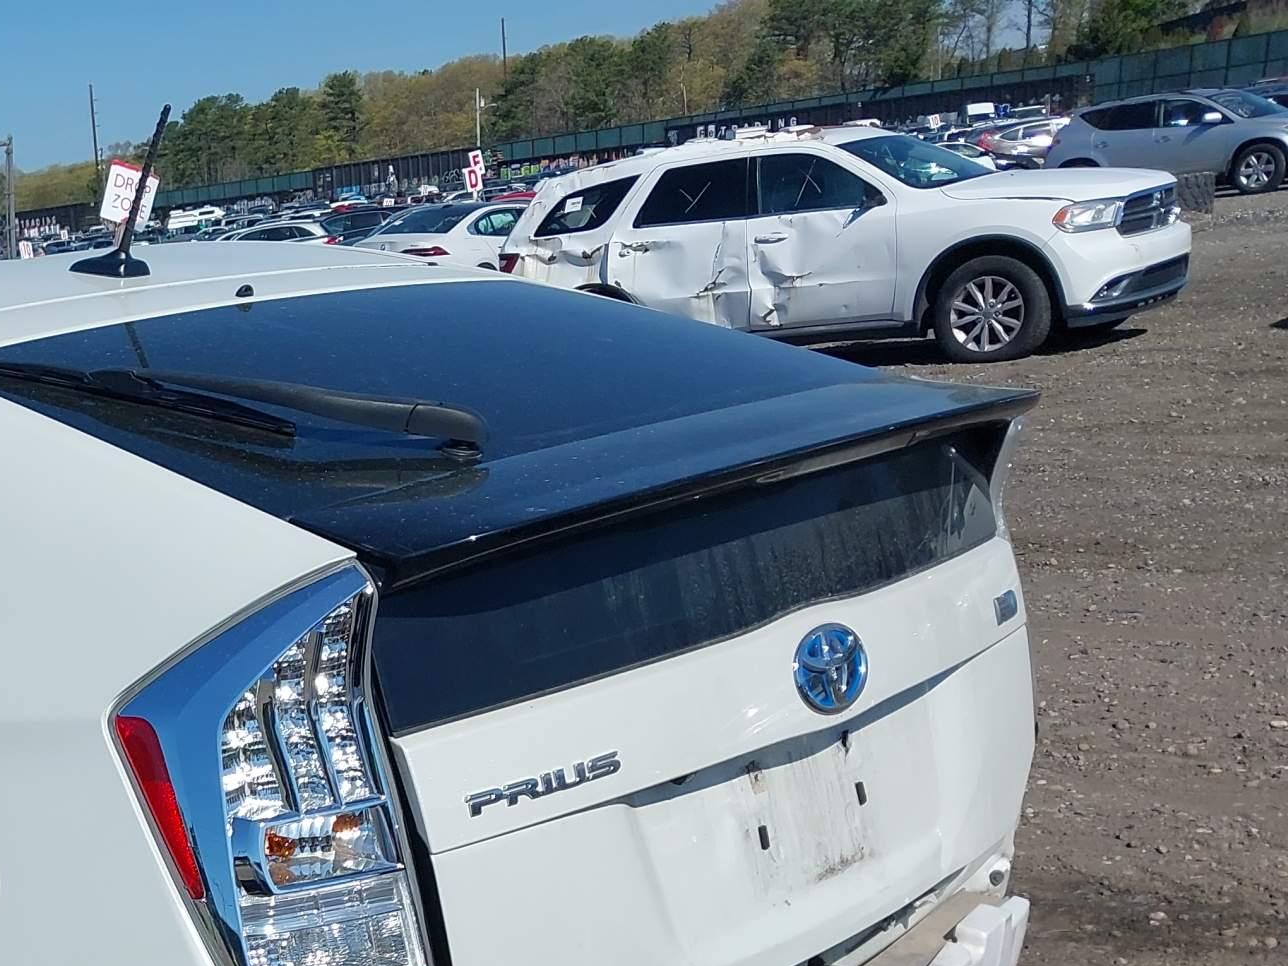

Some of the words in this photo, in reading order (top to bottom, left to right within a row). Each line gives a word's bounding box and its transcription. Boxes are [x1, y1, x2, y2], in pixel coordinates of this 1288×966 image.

[113, 173, 152, 193] DRP
[468, 169, 478, 189] D
[111, 193, 147, 220] ZOE
[464, 750, 622, 818] PRIUS
